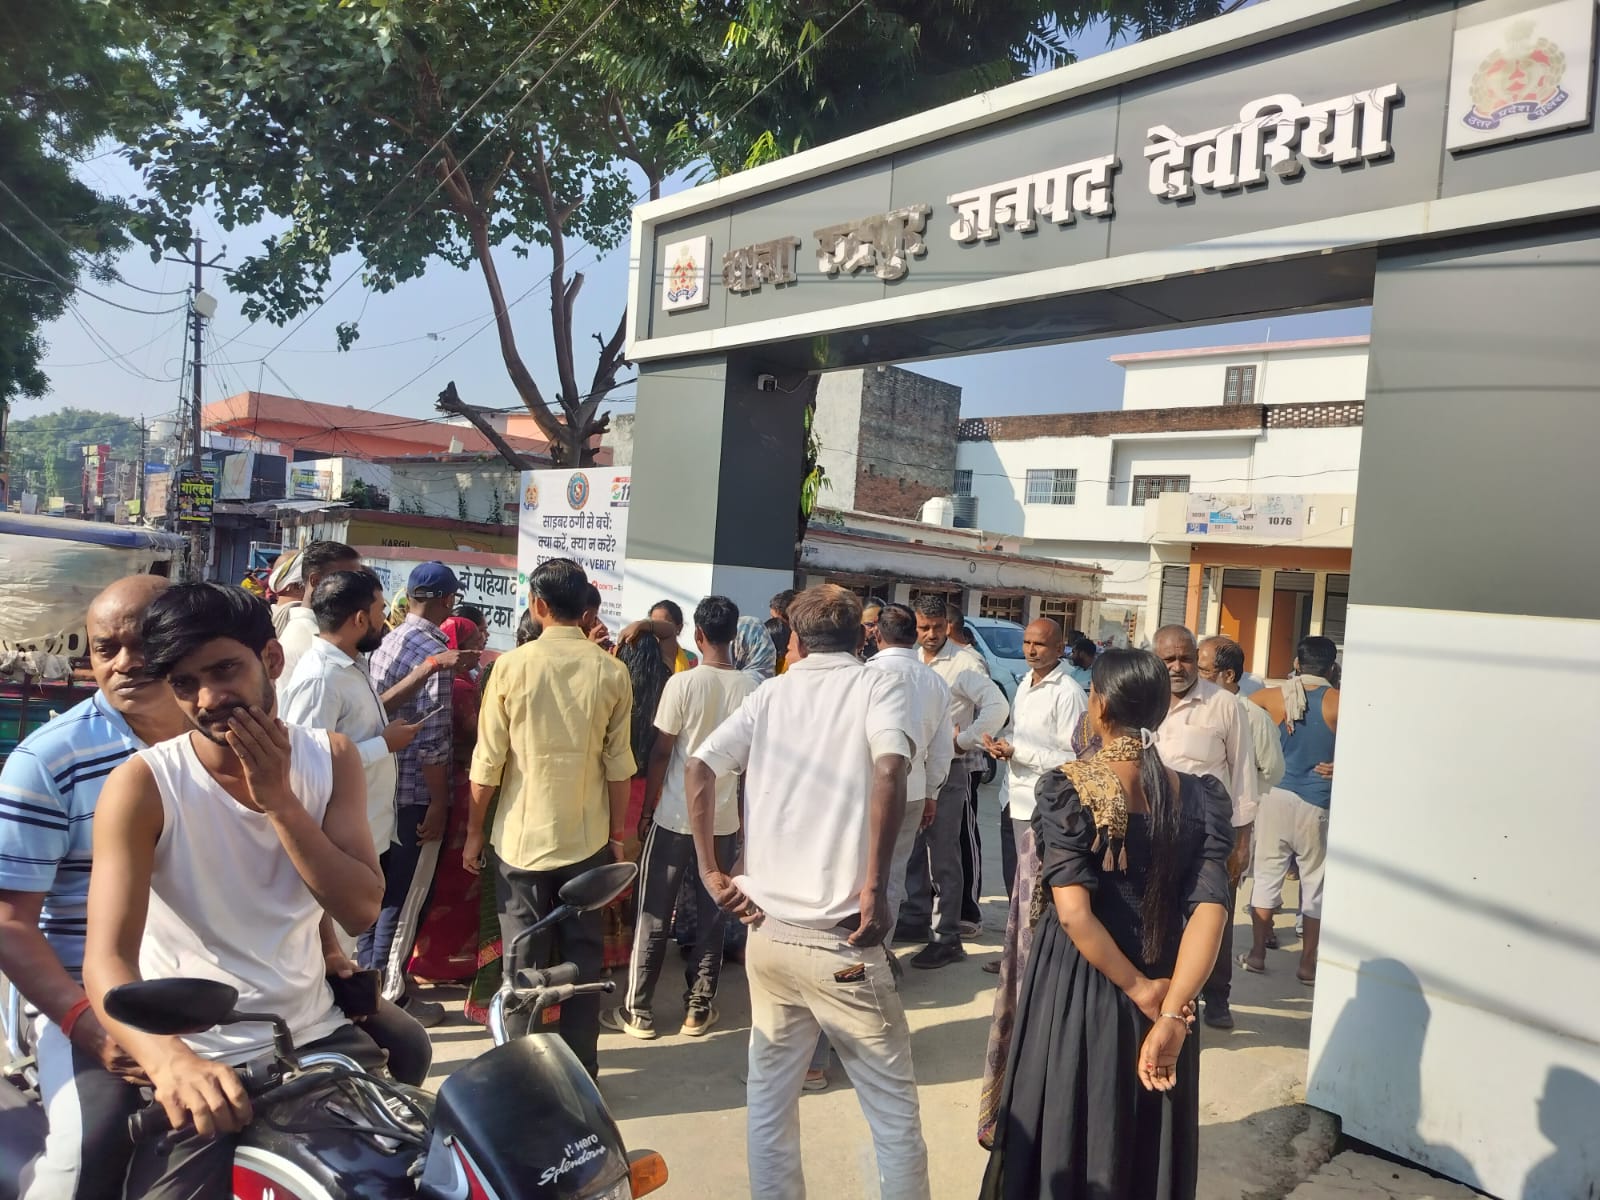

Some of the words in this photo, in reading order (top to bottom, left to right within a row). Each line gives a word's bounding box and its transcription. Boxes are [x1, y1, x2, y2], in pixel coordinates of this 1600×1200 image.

[946, 154, 1119, 241] जनपद
[1143, 82, 1402, 200] देवरिया
[543, 515, 568, 530] साइबर
[569, 511, 586, 529] ठगी
[587, 512, 595, 529] से
[1269, 516, 1292, 526] 1076
[538, 535, 552, 549] क्या
[571, 537, 587, 551] क्या
[588, 537, 596, 551] न
[597, 534, 617, 552] करें?
[590, 558, 616, 571] VERIFY
[474, 568, 510, 597] पहिया
[494, 606, 514, 628] का
